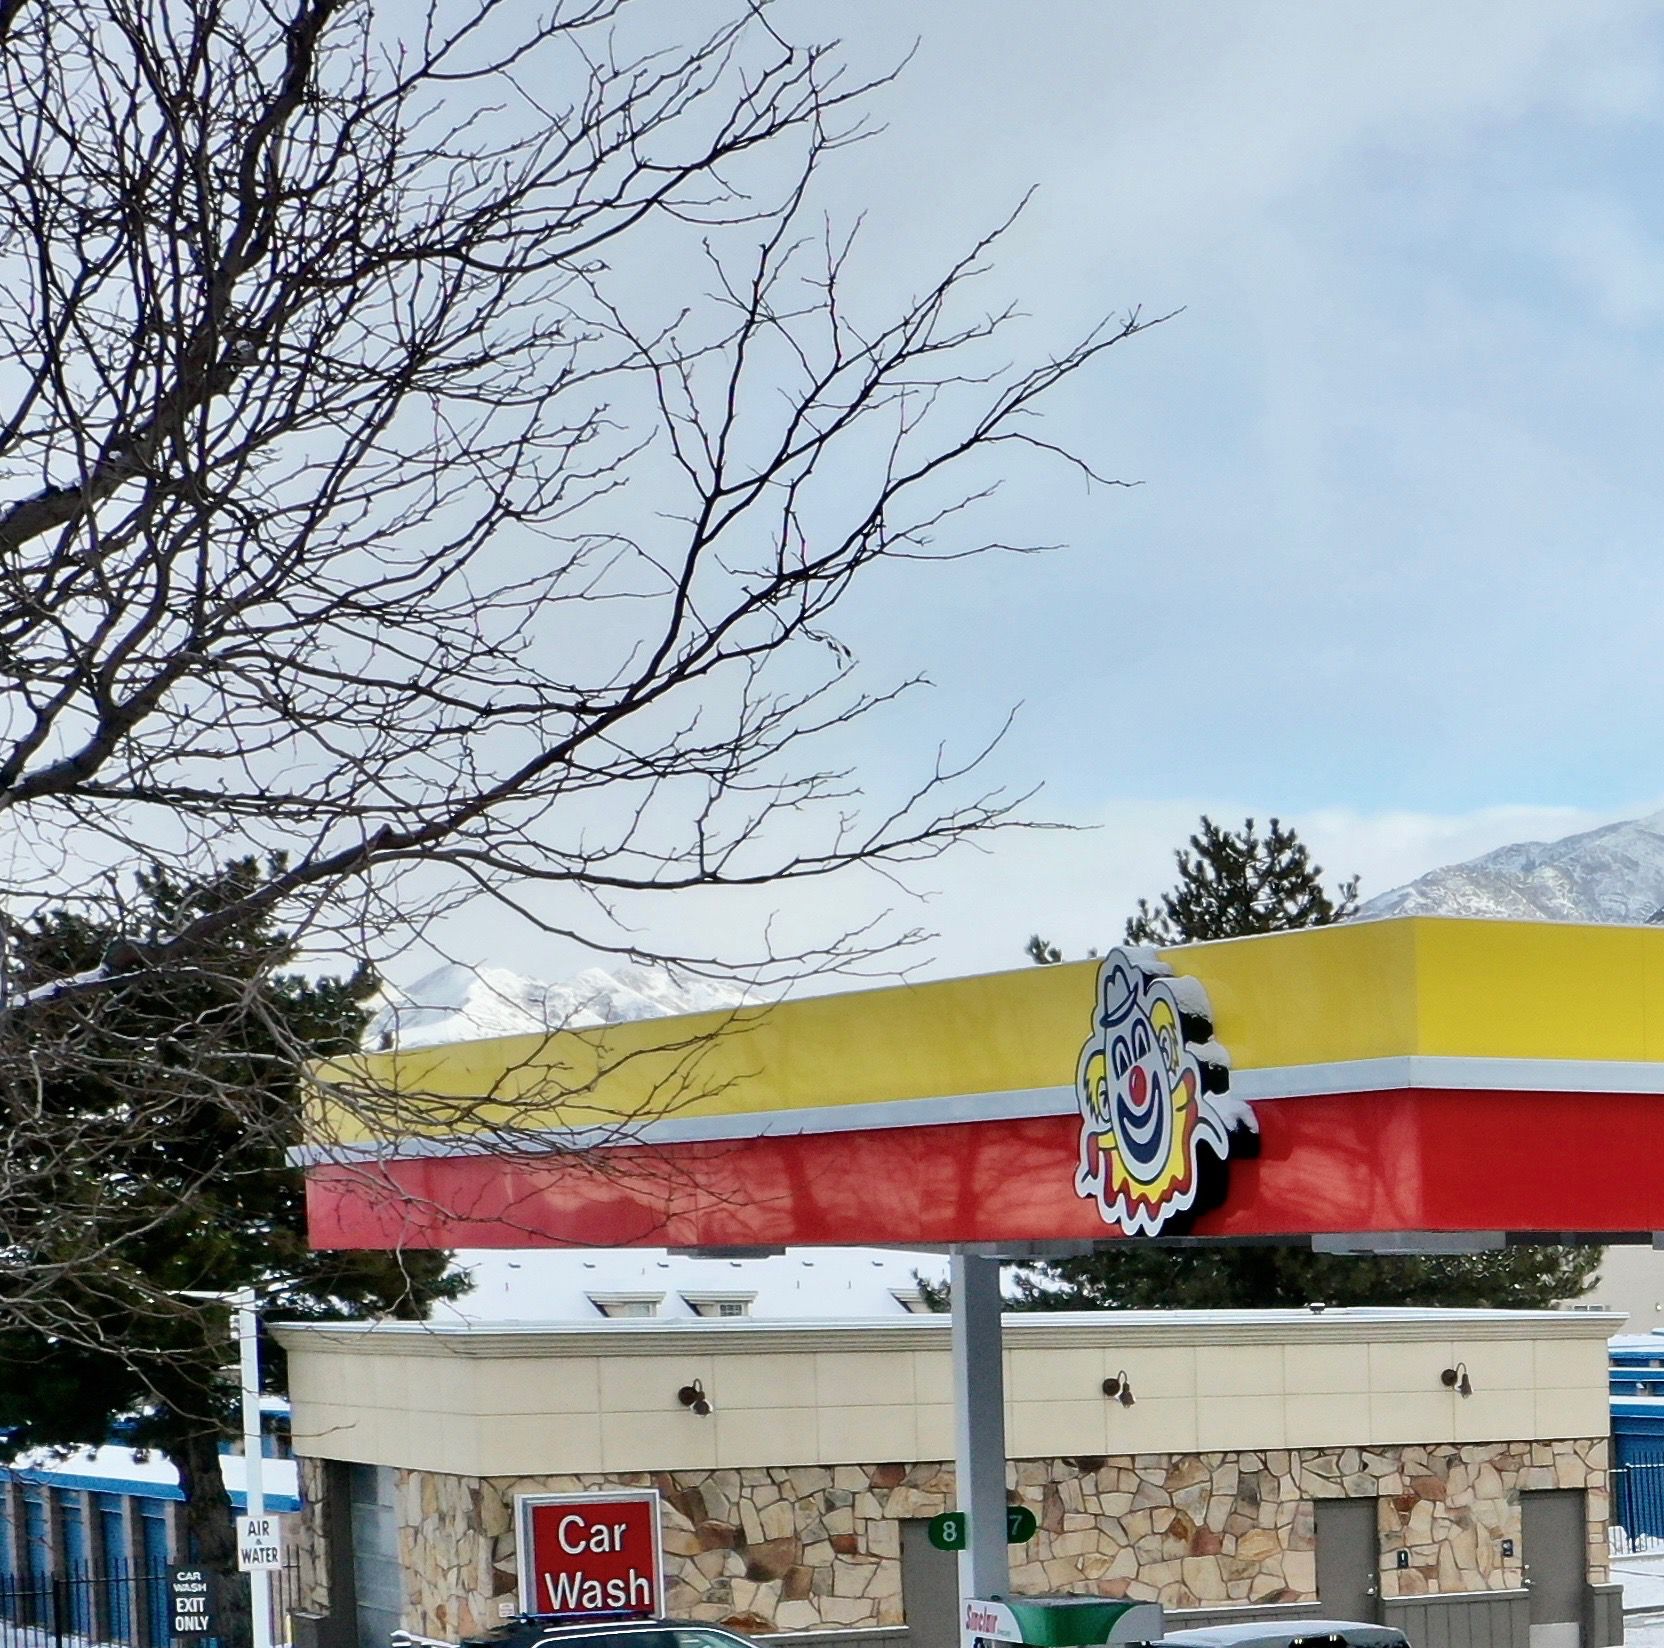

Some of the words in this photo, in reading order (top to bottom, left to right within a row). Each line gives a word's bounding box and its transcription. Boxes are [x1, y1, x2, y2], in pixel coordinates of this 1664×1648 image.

[247, 1520, 270, 1537] AIR
[943, 1520, 957, 1541] 8
[1009, 1514, 1022, 1536] 7
[557, 1514, 628, 1555] Car
[240, 1546, 279, 1564] WATER
[176, 1571, 202, 1581] CAR
[172, 1582, 207, 1592] WASH
[544, 1568, 651, 1611] Wash
[175, 1597, 206, 1613] EXIT
[175, 1615, 209, 1631] ONLY
